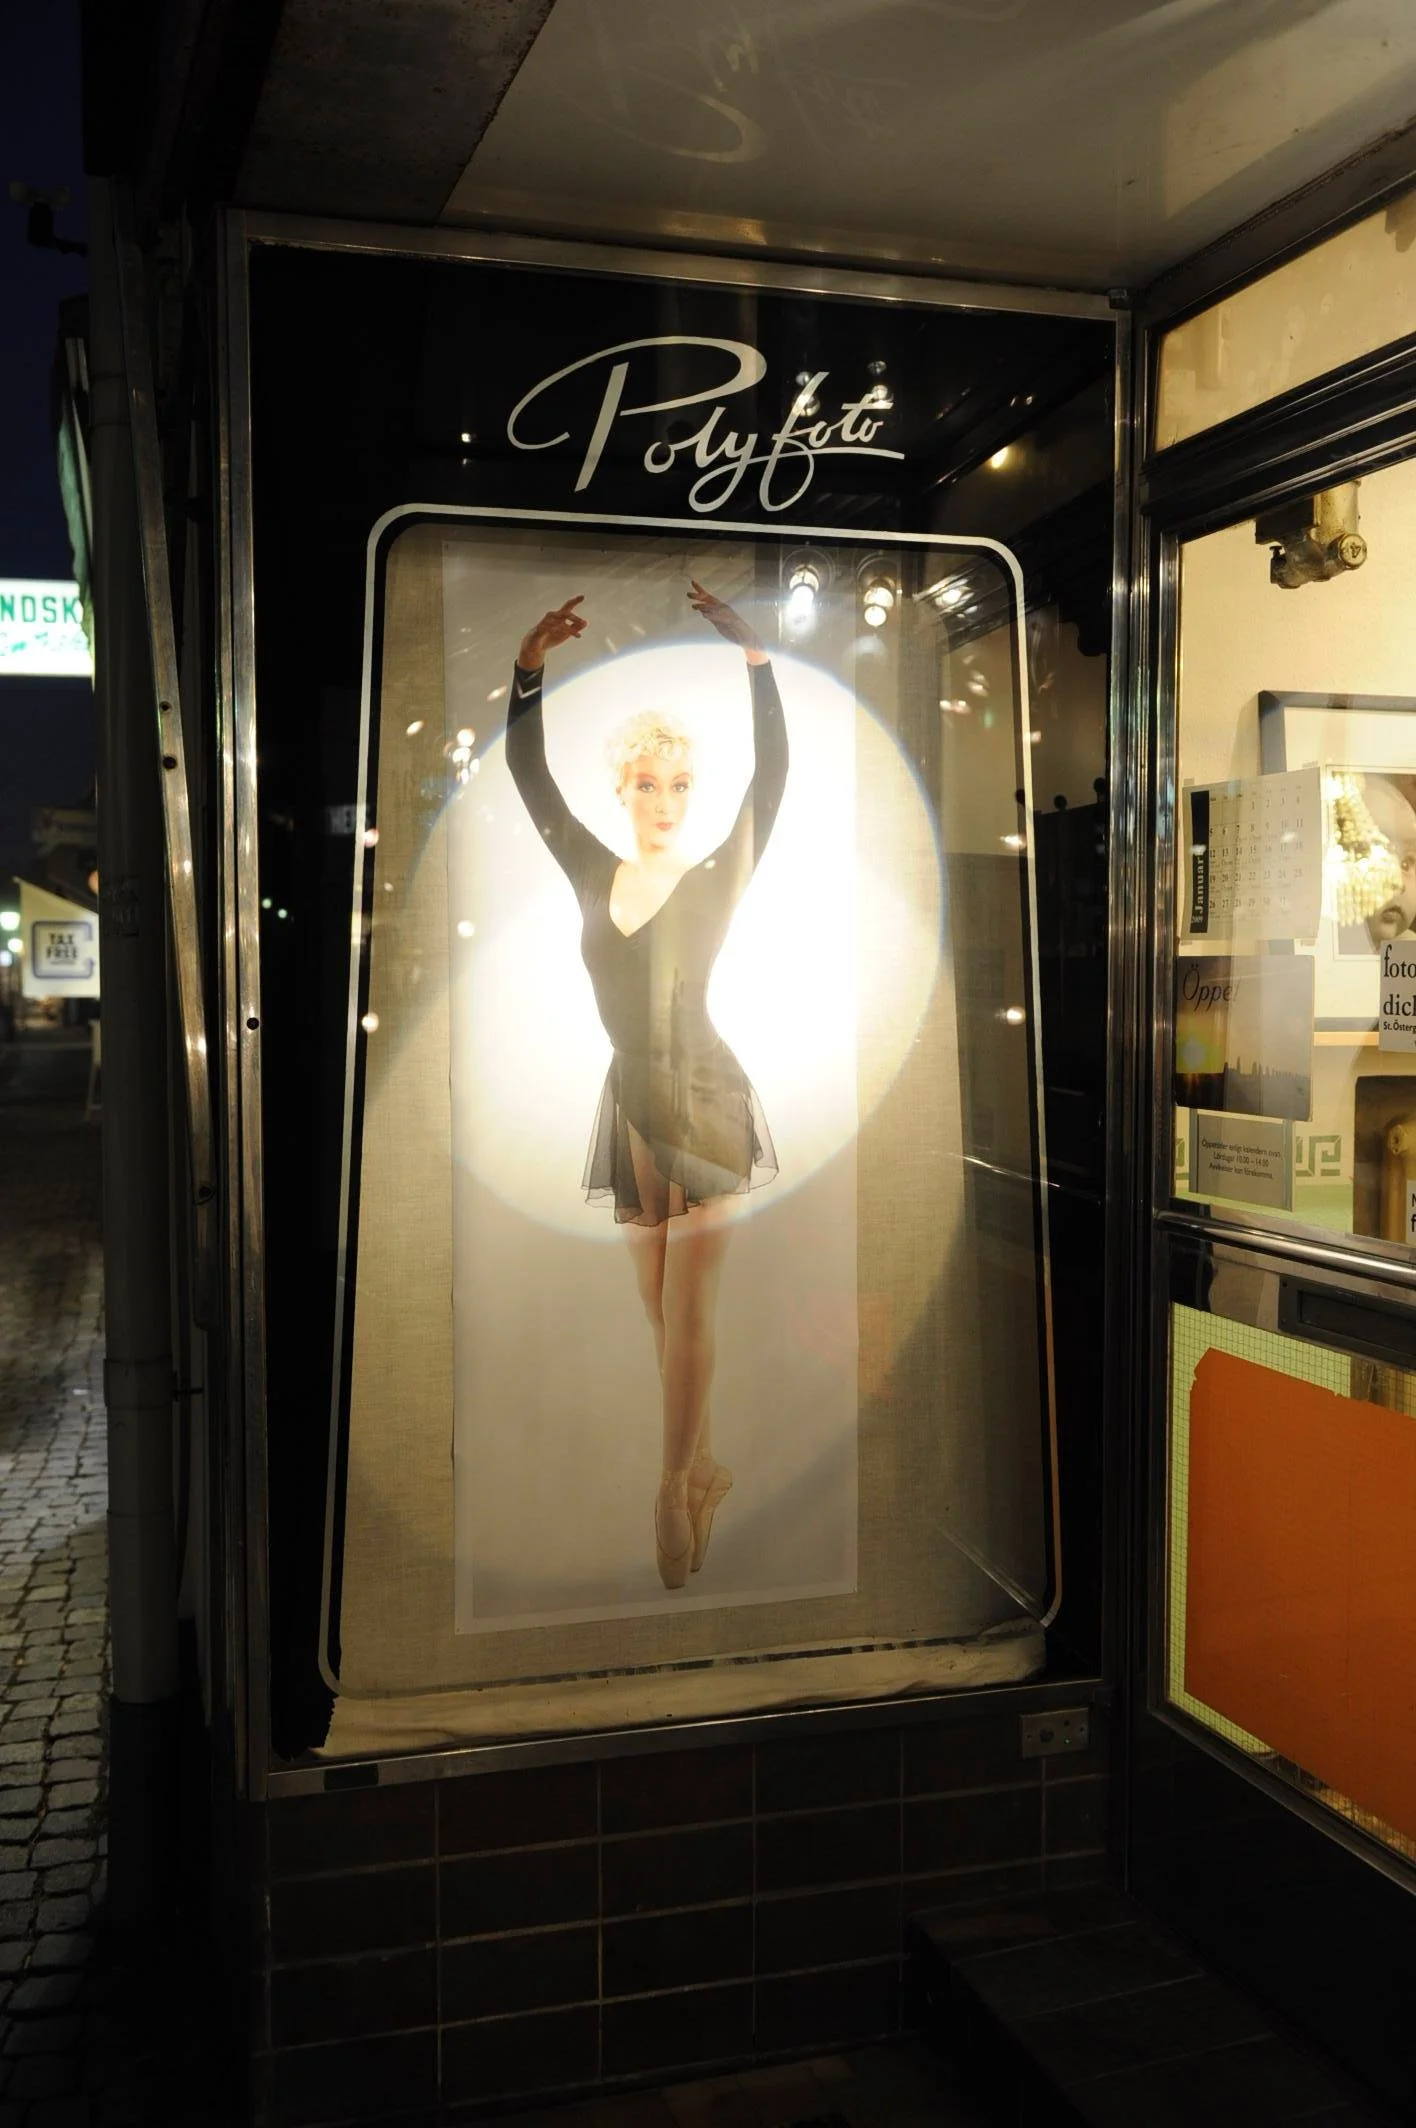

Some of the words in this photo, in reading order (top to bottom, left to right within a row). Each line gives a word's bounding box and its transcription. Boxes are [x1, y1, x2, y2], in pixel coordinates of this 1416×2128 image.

[507, 336, 904, 512] Polyfoto
[1194, 848, 1205, 914] Januar
[48, 933, 74, 945] TAX
[46, 946, 77, 959] FREE
[1383, 994, 1416, 1017] dic
